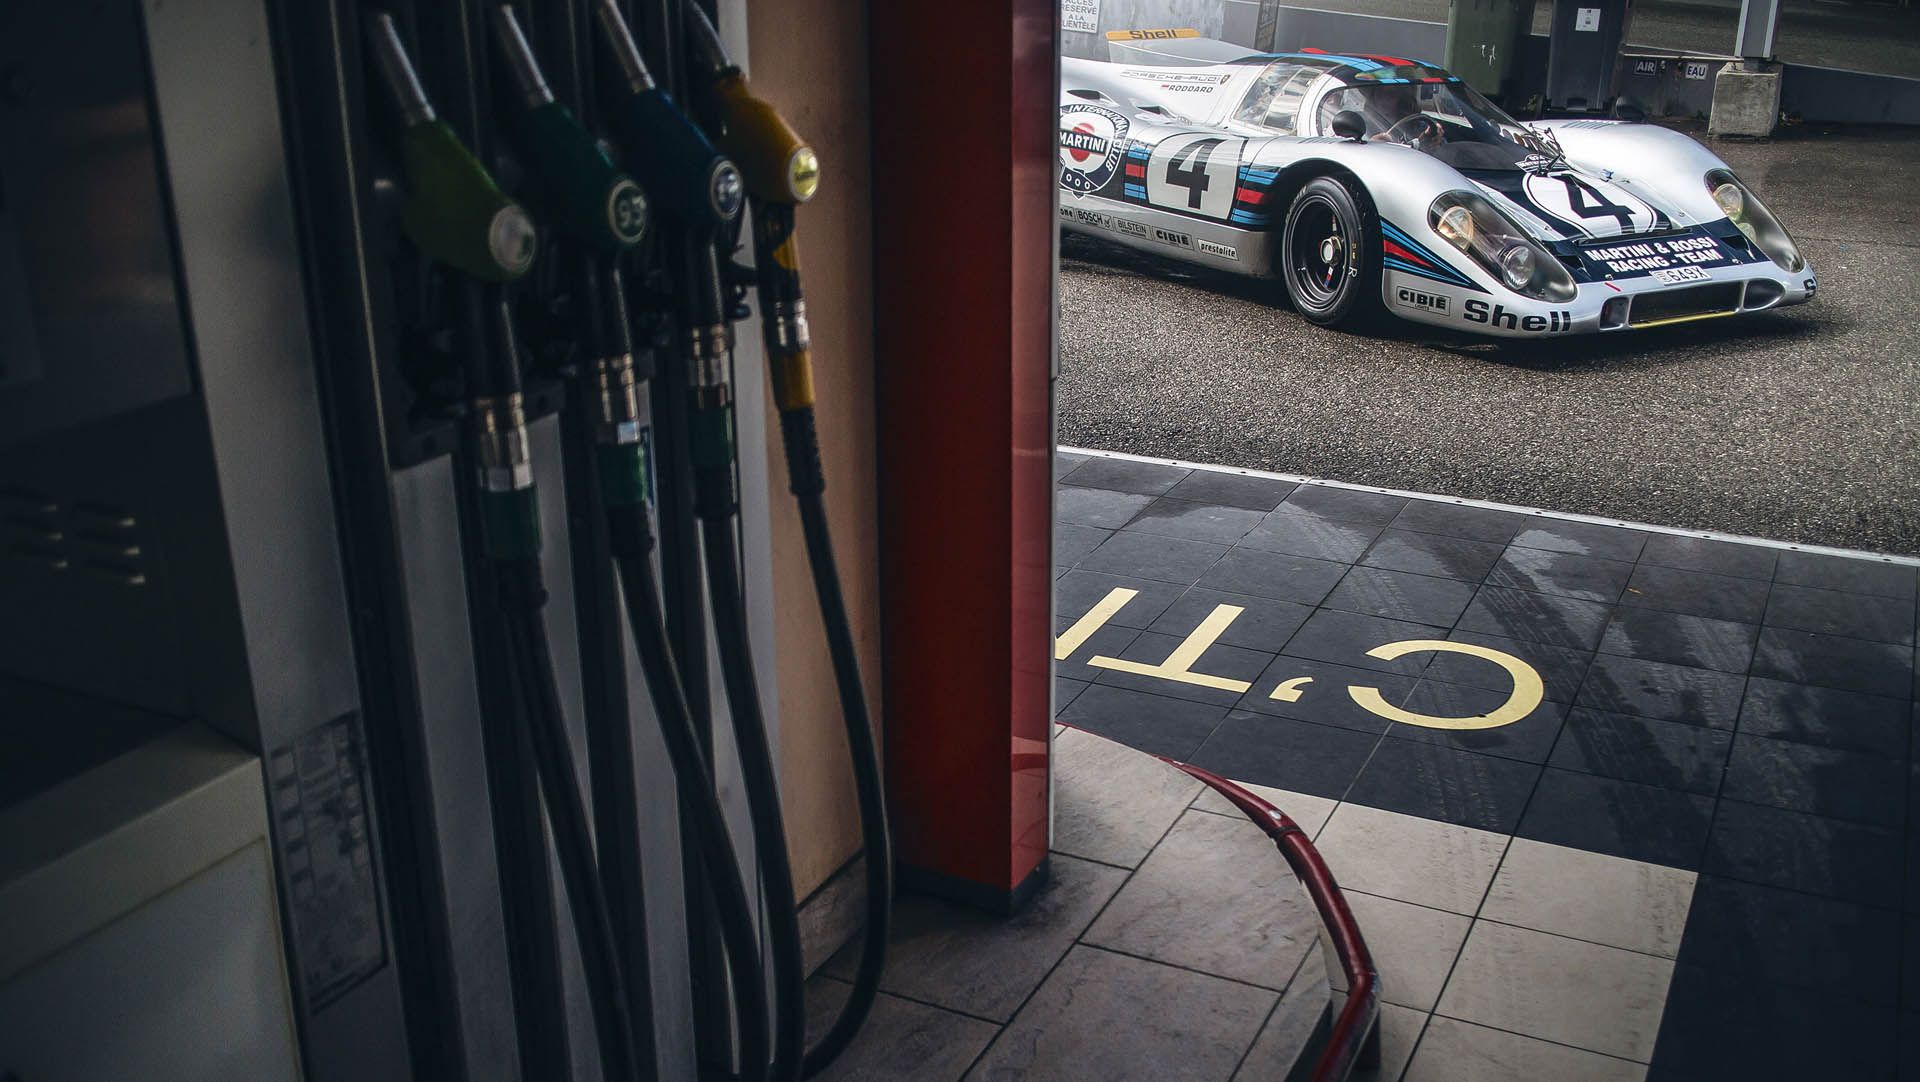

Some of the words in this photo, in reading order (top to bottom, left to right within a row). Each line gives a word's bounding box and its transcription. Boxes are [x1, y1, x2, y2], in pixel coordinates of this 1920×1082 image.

[1129, 29, 1177, 39] Shell
[1636, 62, 1655, 73] AIR
[1687, 65, 1706, 78] EAU
[1060, 131, 1106, 153] MARTINI
[1106, 140, 1122, 172] CLUB
[1166, 138, 1227, 209] 4
[1561, 173, 1637, 234] 4
[1078, 210, 1104, 225] BOSCH
[1118, 219, 1147, 235] BILSTEIN
[1201, 243, 1236, 258] prestolite
[1584, 243, 1656, 261] MARTINI
[1654, 242, 1671, 254] &
[1666, 236, 1719, 252] ROSSI
[1606, 256, 1670, 273] RACING
[1674, 248, 1724, 264] TEAM
[1463, 299, 1572, 332] Shell
[1055, 586, 1545, 730] C'T
